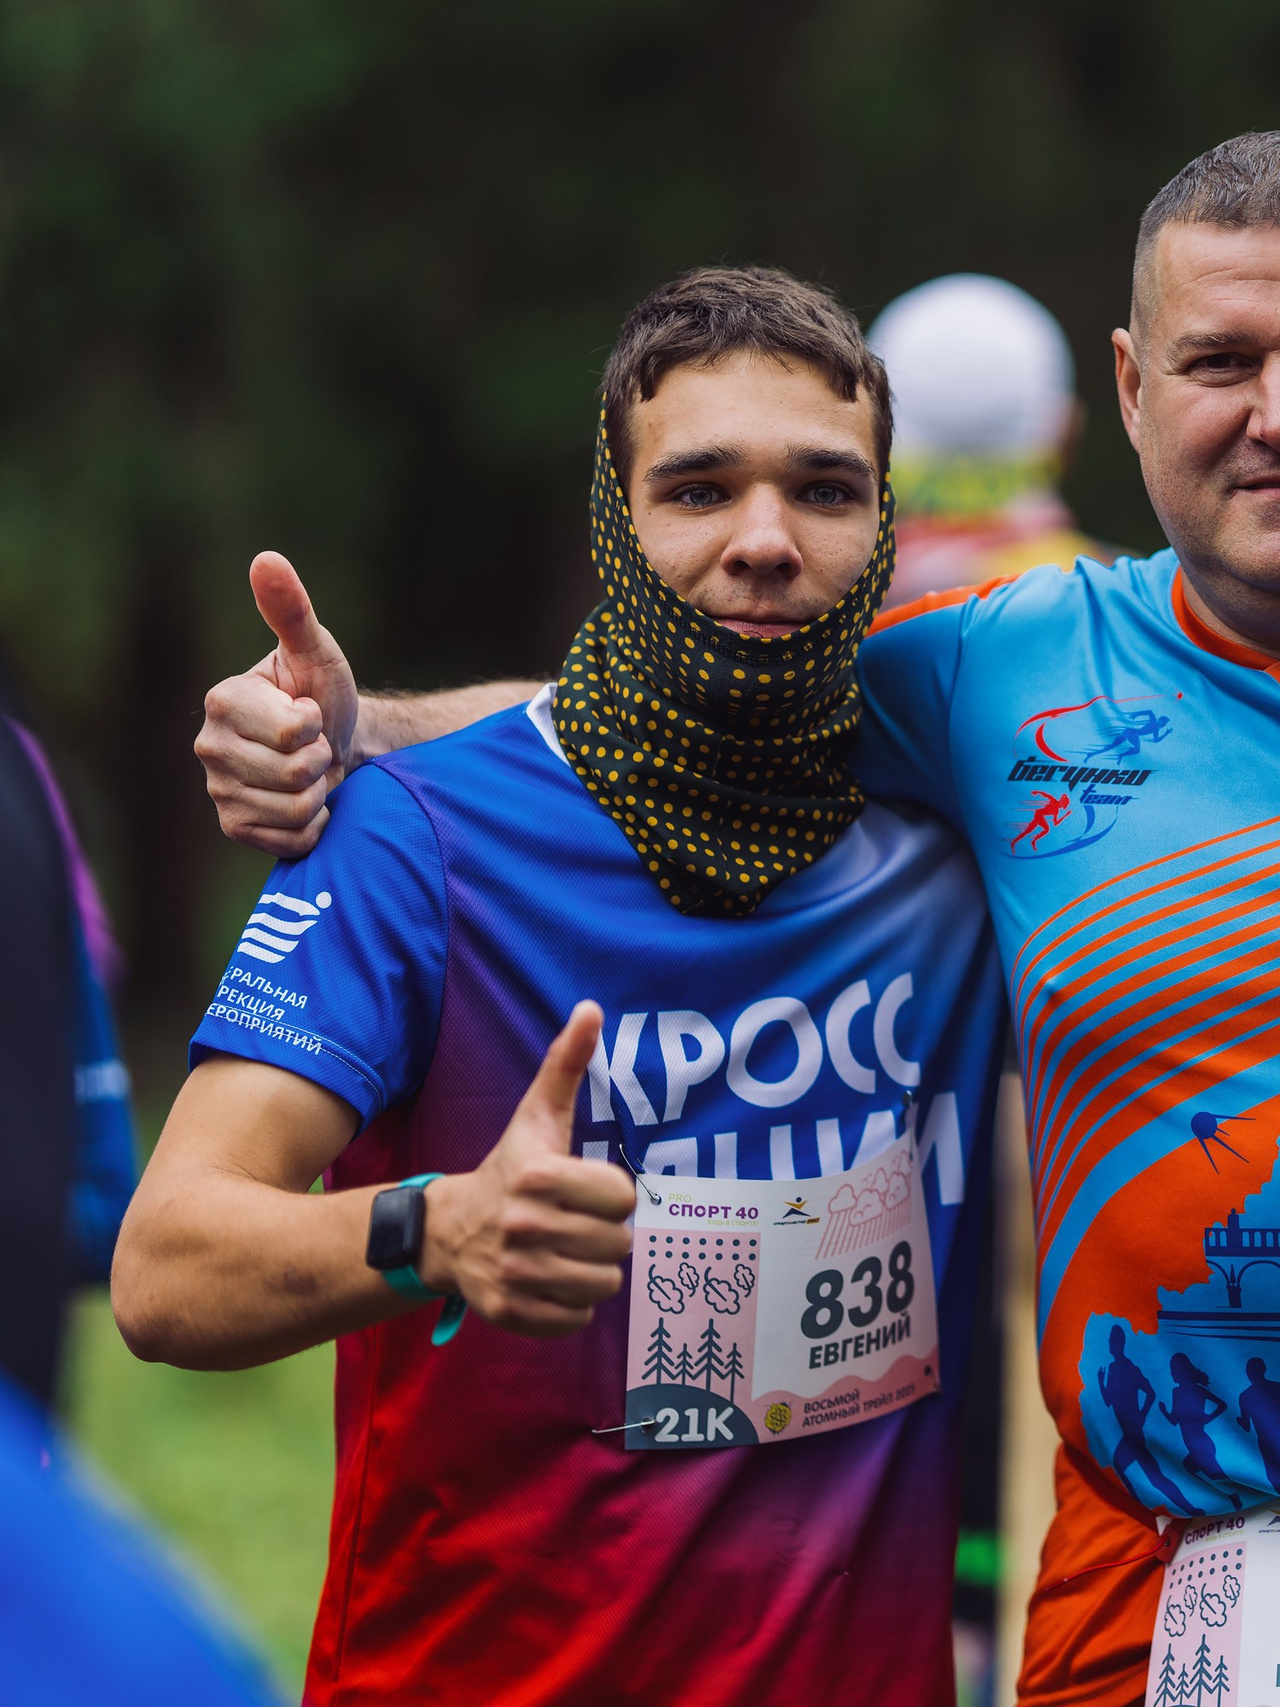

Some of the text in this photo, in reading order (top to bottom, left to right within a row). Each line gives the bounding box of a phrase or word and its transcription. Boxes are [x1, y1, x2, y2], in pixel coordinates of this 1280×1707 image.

[1079, 784, 1134, 805] team
[226, 966, 308, 1009] РАЛЬНАЯ
[586, 972, 920, 1127] КРОСС
[668, 1193, 692, 1203] PRO
[668, 1204, 759, 1220] СПОРТ 40
[800, 1240, 914, 1340] 838
[809, 1311, 911, 1370] ЕВГЕНИЙ
[802, 1403, 861, 1428] АТОМНЫЙ
[803, 1388, 861, 1414] ВОСЬМОЙ
[654, 1406, 734, 1443] 21K
[1184, 1520, 1224, 1545] СПОРТ
[1225, 1516, 1245, 1530] 40
